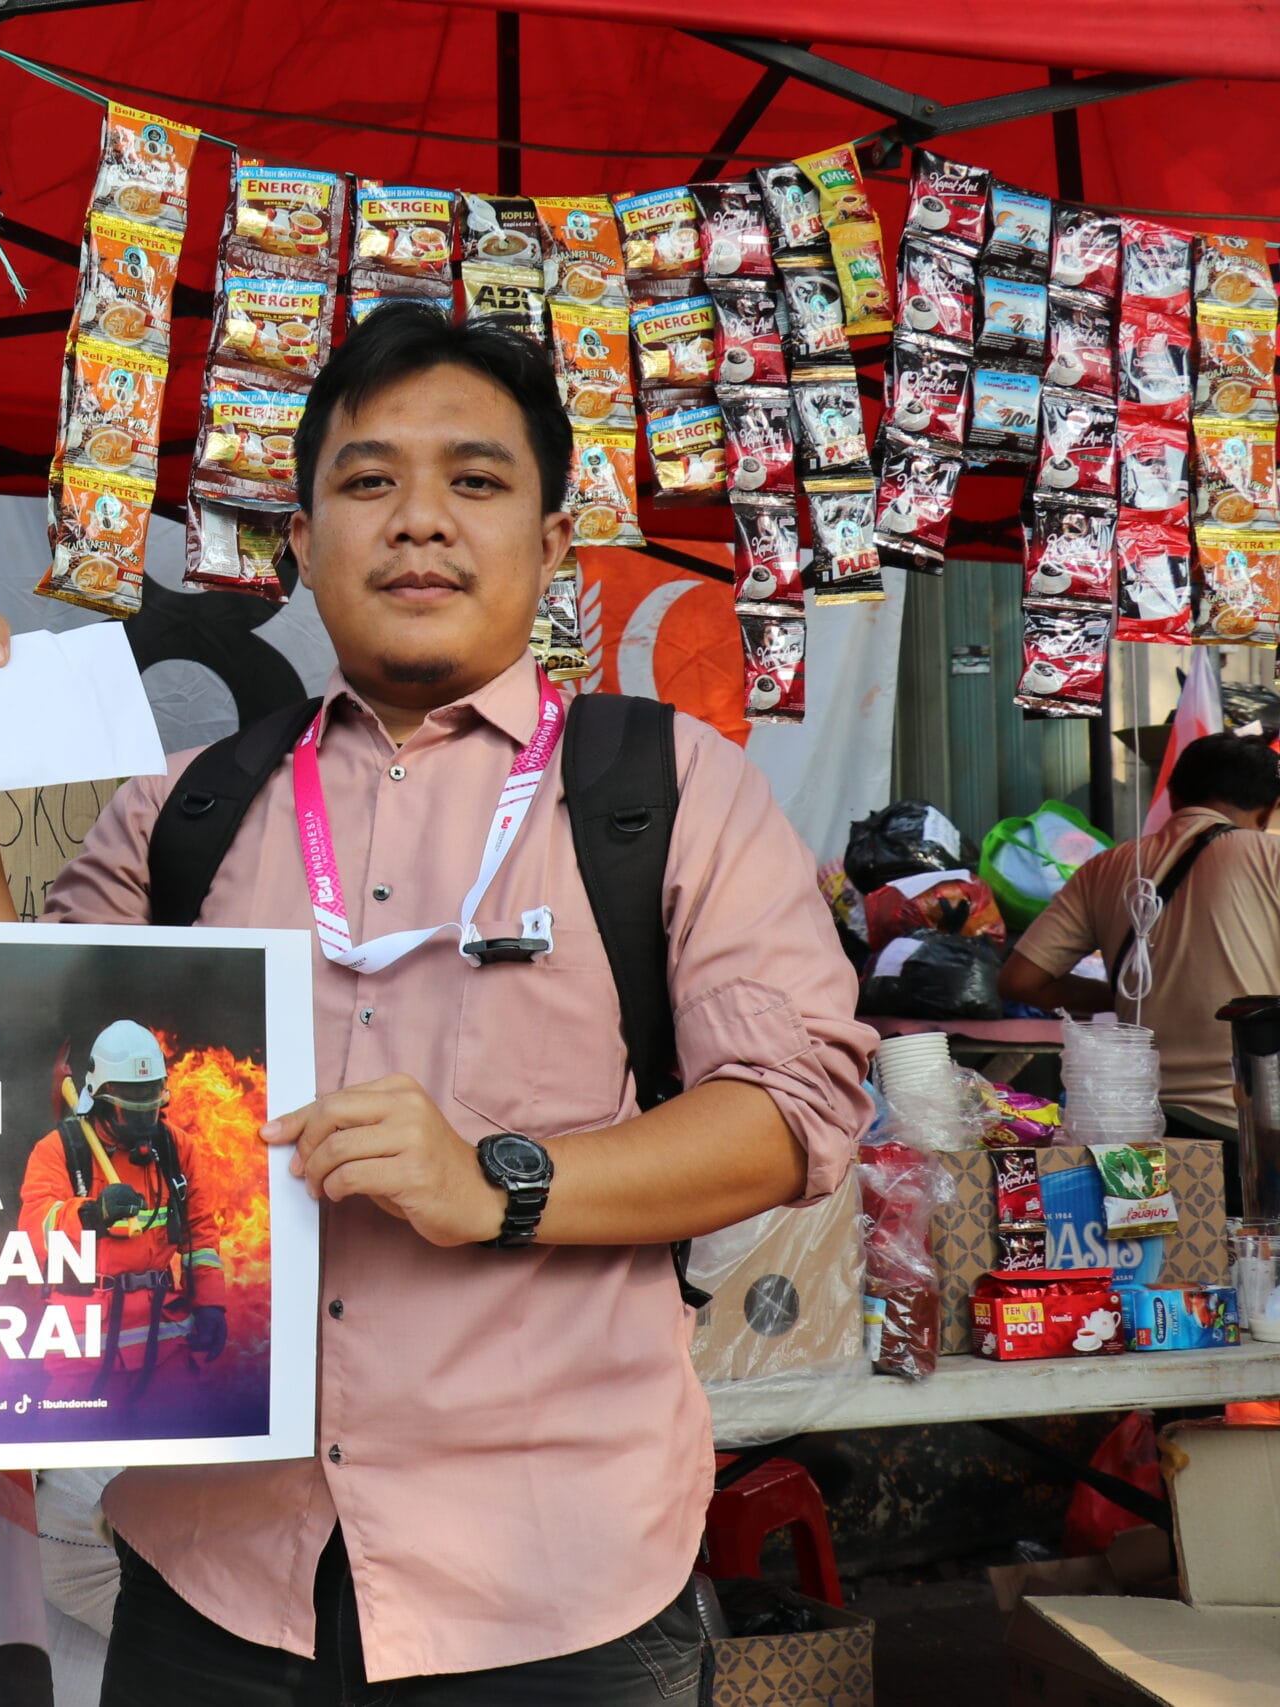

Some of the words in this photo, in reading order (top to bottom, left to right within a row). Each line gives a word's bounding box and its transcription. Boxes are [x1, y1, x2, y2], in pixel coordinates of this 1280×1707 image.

[114, 105, 136, 117] Beli
[247, 180, 323, 199] ENERGEN
[929, 172, 956, 192] Kapal
[957, 180, 979, 195] Api
[368, 201, 444, 214] ENERGEN
[501, 211, 521, 220] KOPI
[522, 212, 536, 220] SU
[627, 201, 693, 224] ENERGEN
[96, 225, 117, 237] Beli
[130, 235, 166, 250] EXTRA
[560, 225, 598, 242] TOP
[236, 290, 314, 308] ENERGEN
[642, 311, 710, 335] ENERGEN
[116, 358, 152, 373] EXTRA
[908, 371, 936, 393] Kapal
[935, 379, 958, 394] Api
[220, 404, 300, 422] ENERGEN
[1084, 431, 1104, 447] Api
[68, 476, 89, 488] Beli
[102, 485, 139, 500] EXTRA
[837, 551, 879, 576] PLUS
[526, 721, 554, 769] INDONESIA
[304, 810, 323, 874] INDONESIA
[998, 1173, 1021, 1190] Kapal
[1021, 1171, 1036, 1184] Api
[1131, 1206, 1170, 1220] Anlene
[1003, 1256, 1027, 1272] Kapal
[1027, 1254, 1045, 1268] Api
[1005, 1307, 1021, 1315] TEH
[976, 1316, 991, 1325] POCI
[1006, 1323, 1044, 1336] POCI
[1156, 1301, 1165, 1340] SariWangi
